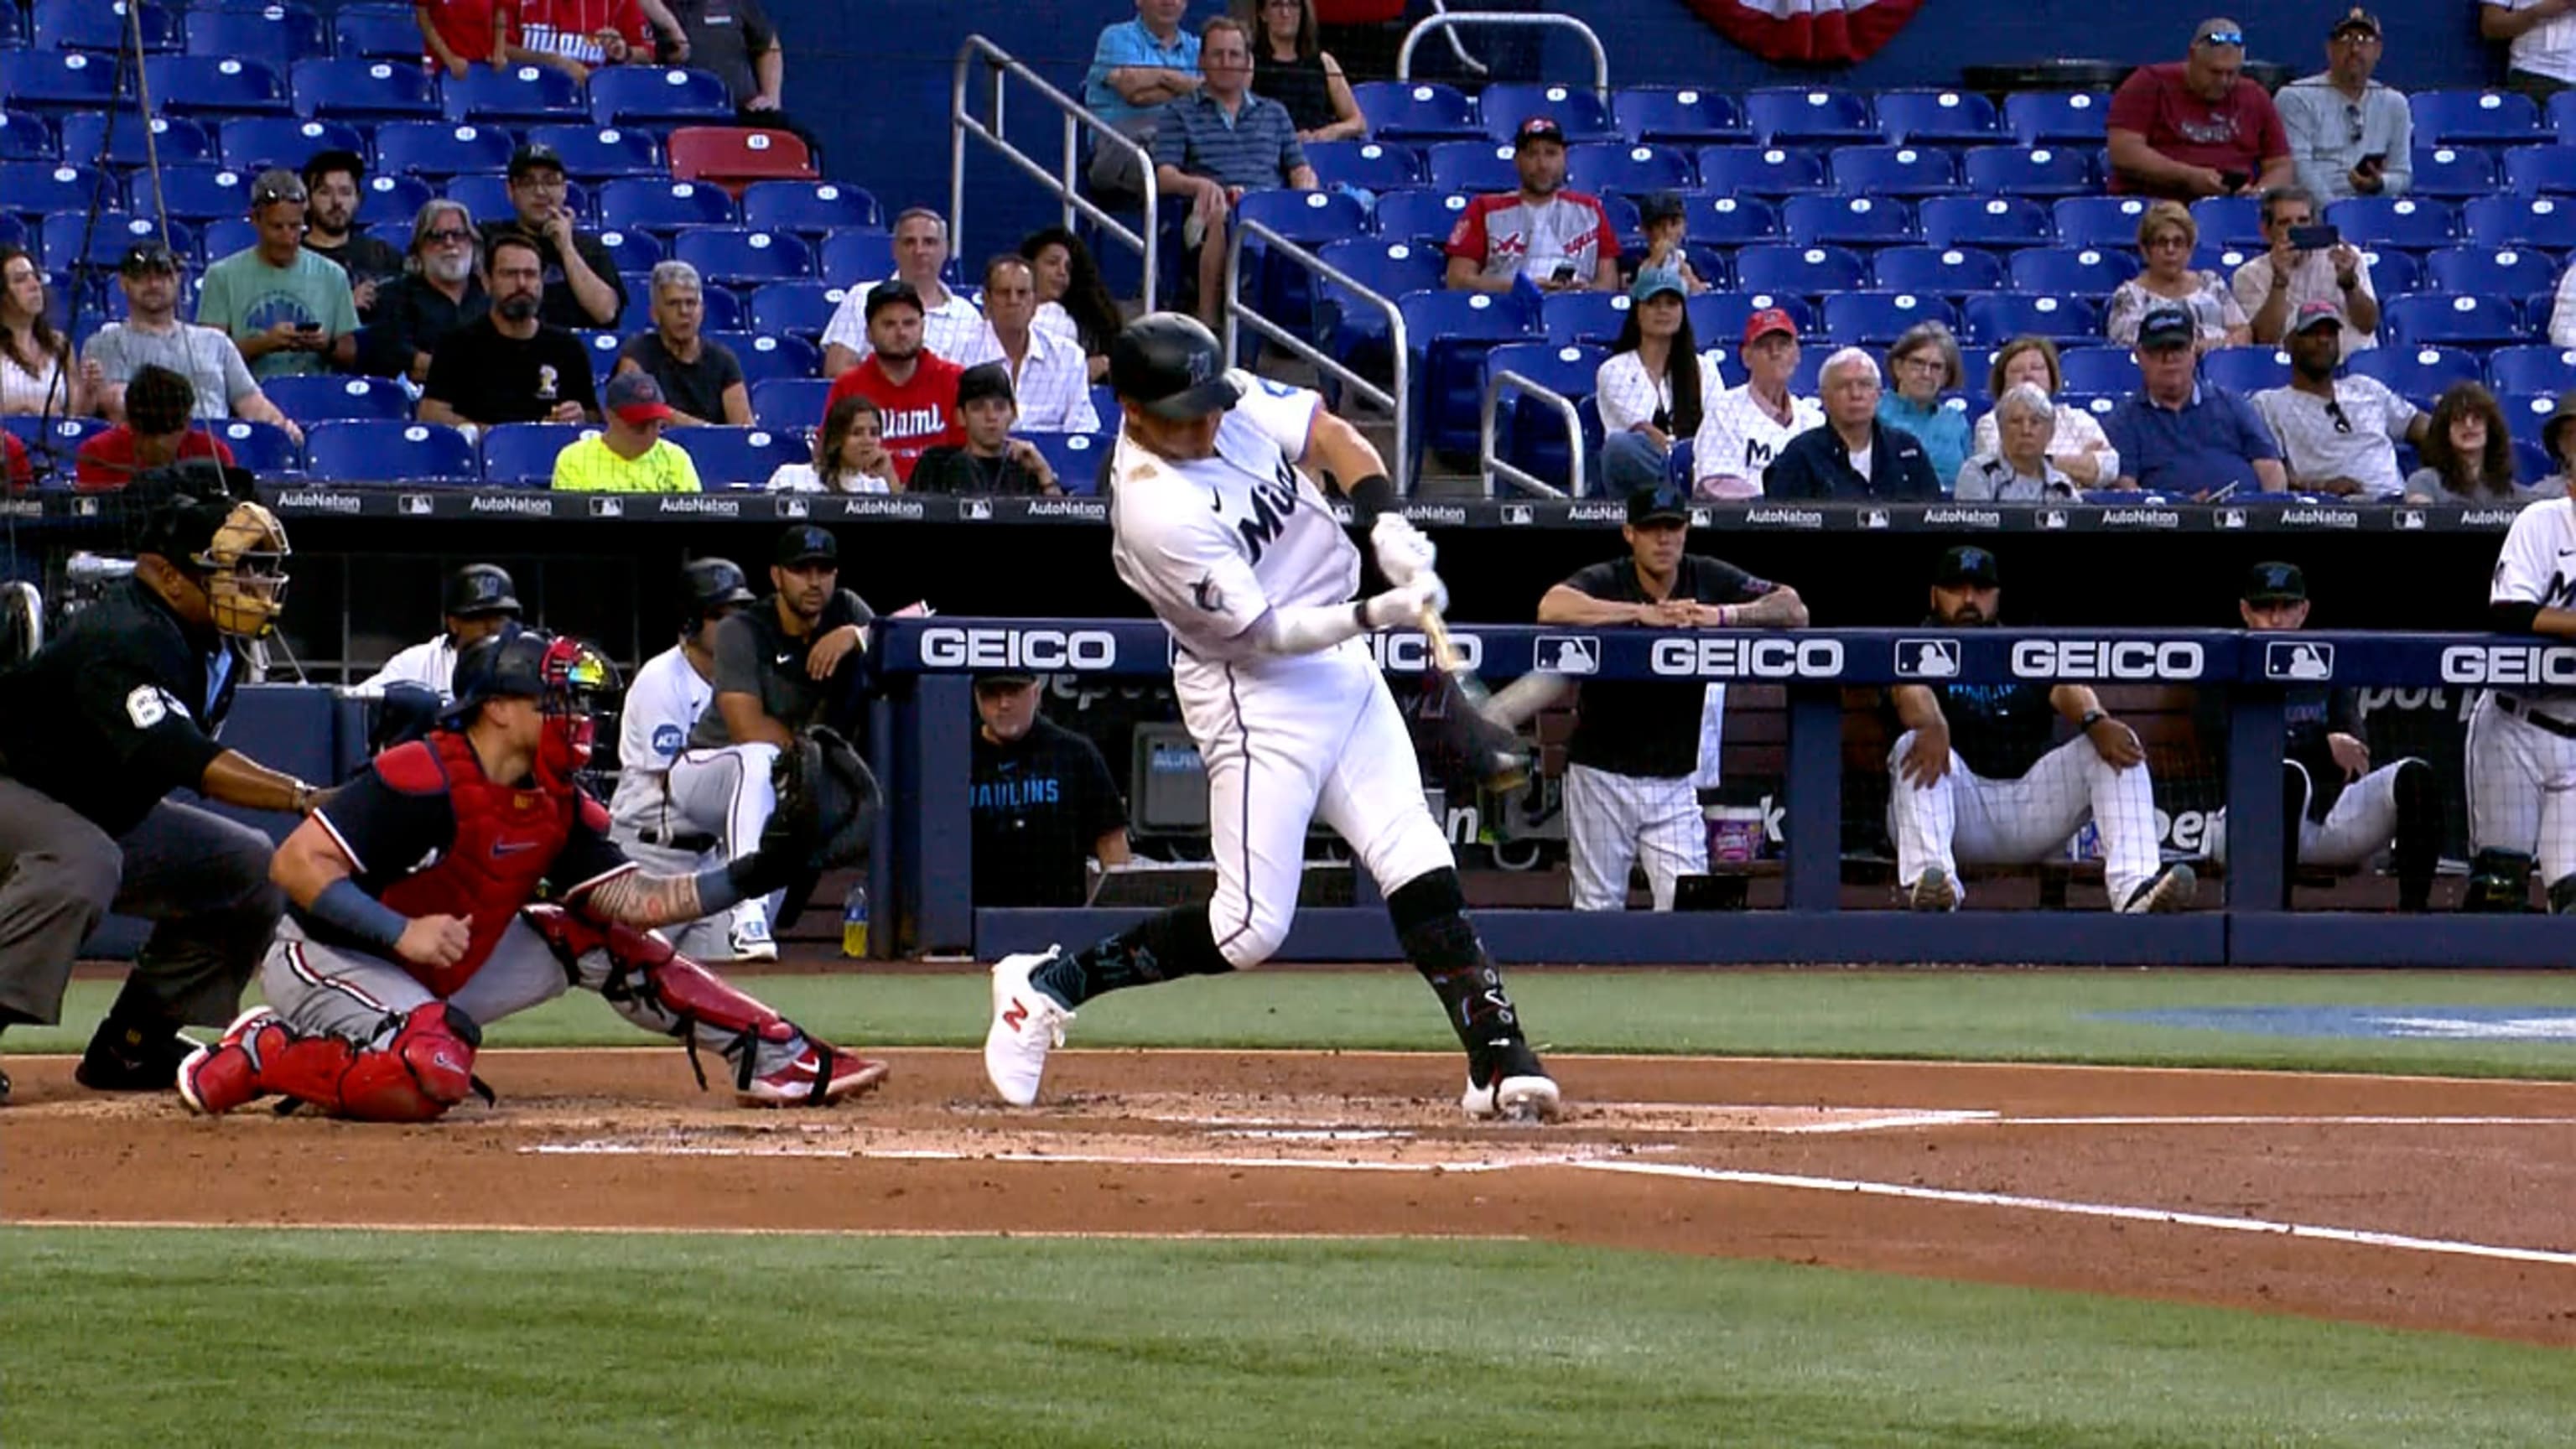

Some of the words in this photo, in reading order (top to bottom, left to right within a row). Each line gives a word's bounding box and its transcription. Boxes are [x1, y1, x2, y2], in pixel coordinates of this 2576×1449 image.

[278, 491, 361, 510] AutoNation
[470, 496, 553, 512] AutoNation
[660, 497, 740, 513] AutoNation
[844, 499, 923, 515] AutoNation
[1027, 501, 1106, 517] AutoNation
[1400, 505, 1466, 522] utoNation
[1745, 508, 1823, 524] AutoNation
[1923, 508, 2000, 524] AutoNation
[2102, 509, 2179, 525] AutoNation
[2281, 510, 2358, 526] AutoNation
[921, 627, 1116, 670] GEICO
[1364, 633, 1483, 671] ICO
[1650, 638, 1844, 677] GEICO
[2011, 640, 2205, 678] GEICO
[2441, 646, 2576, 684] GEIC
